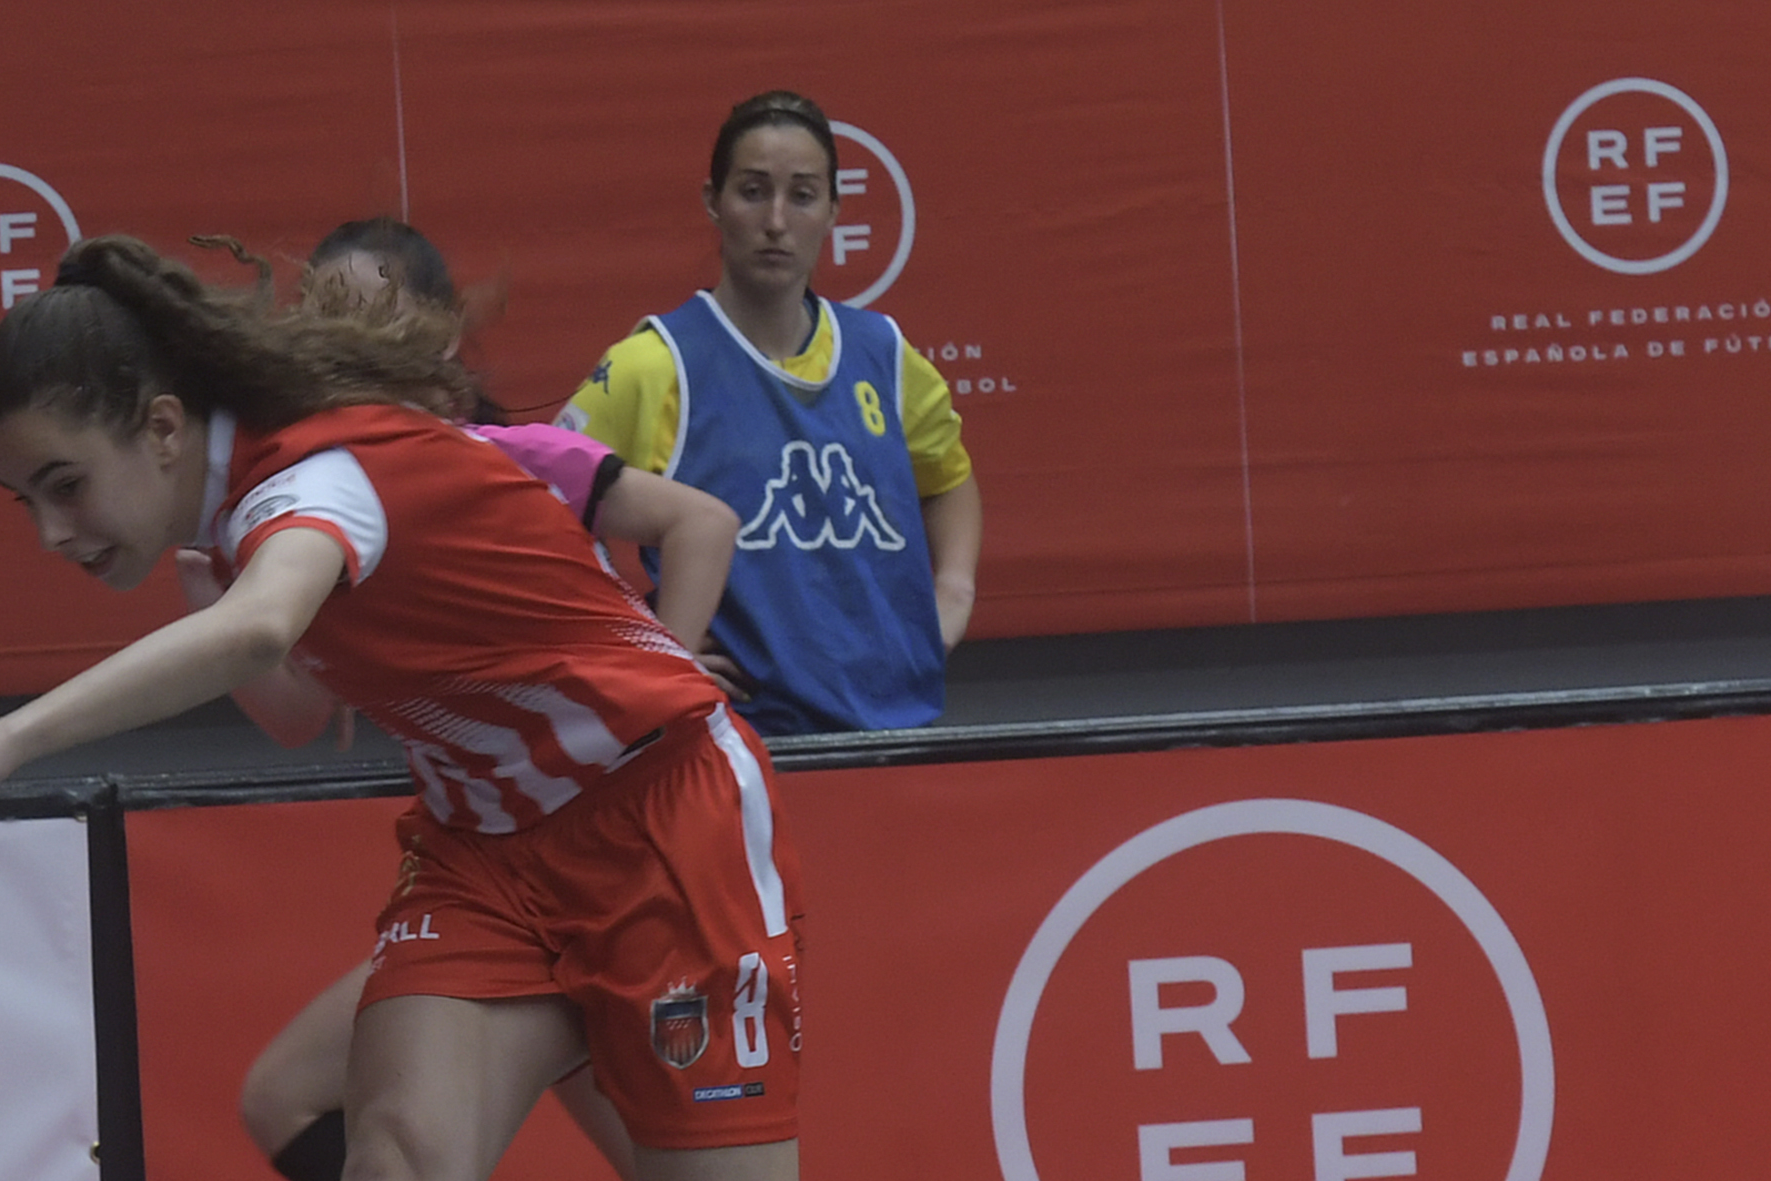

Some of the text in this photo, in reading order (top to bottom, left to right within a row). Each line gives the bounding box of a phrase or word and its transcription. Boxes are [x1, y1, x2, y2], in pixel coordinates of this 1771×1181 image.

[1587, 126, 1683, 171] RF
[835, 168, 869, 195] F
[1590, 182, 1686, 226] EF
[832, 225, 871, 266] F
[1491, 298, 1771, 330] REAL FEDERACIÓ
[1462, 333, 1771, 367] ESPAÑOLA DE FÚT
[956, 377, 1017, 395] BOL
[853, 380, 886, 437] 8
[732, 952, 770, 1068] 8
[1128, 942, 1413, 1070] RF
